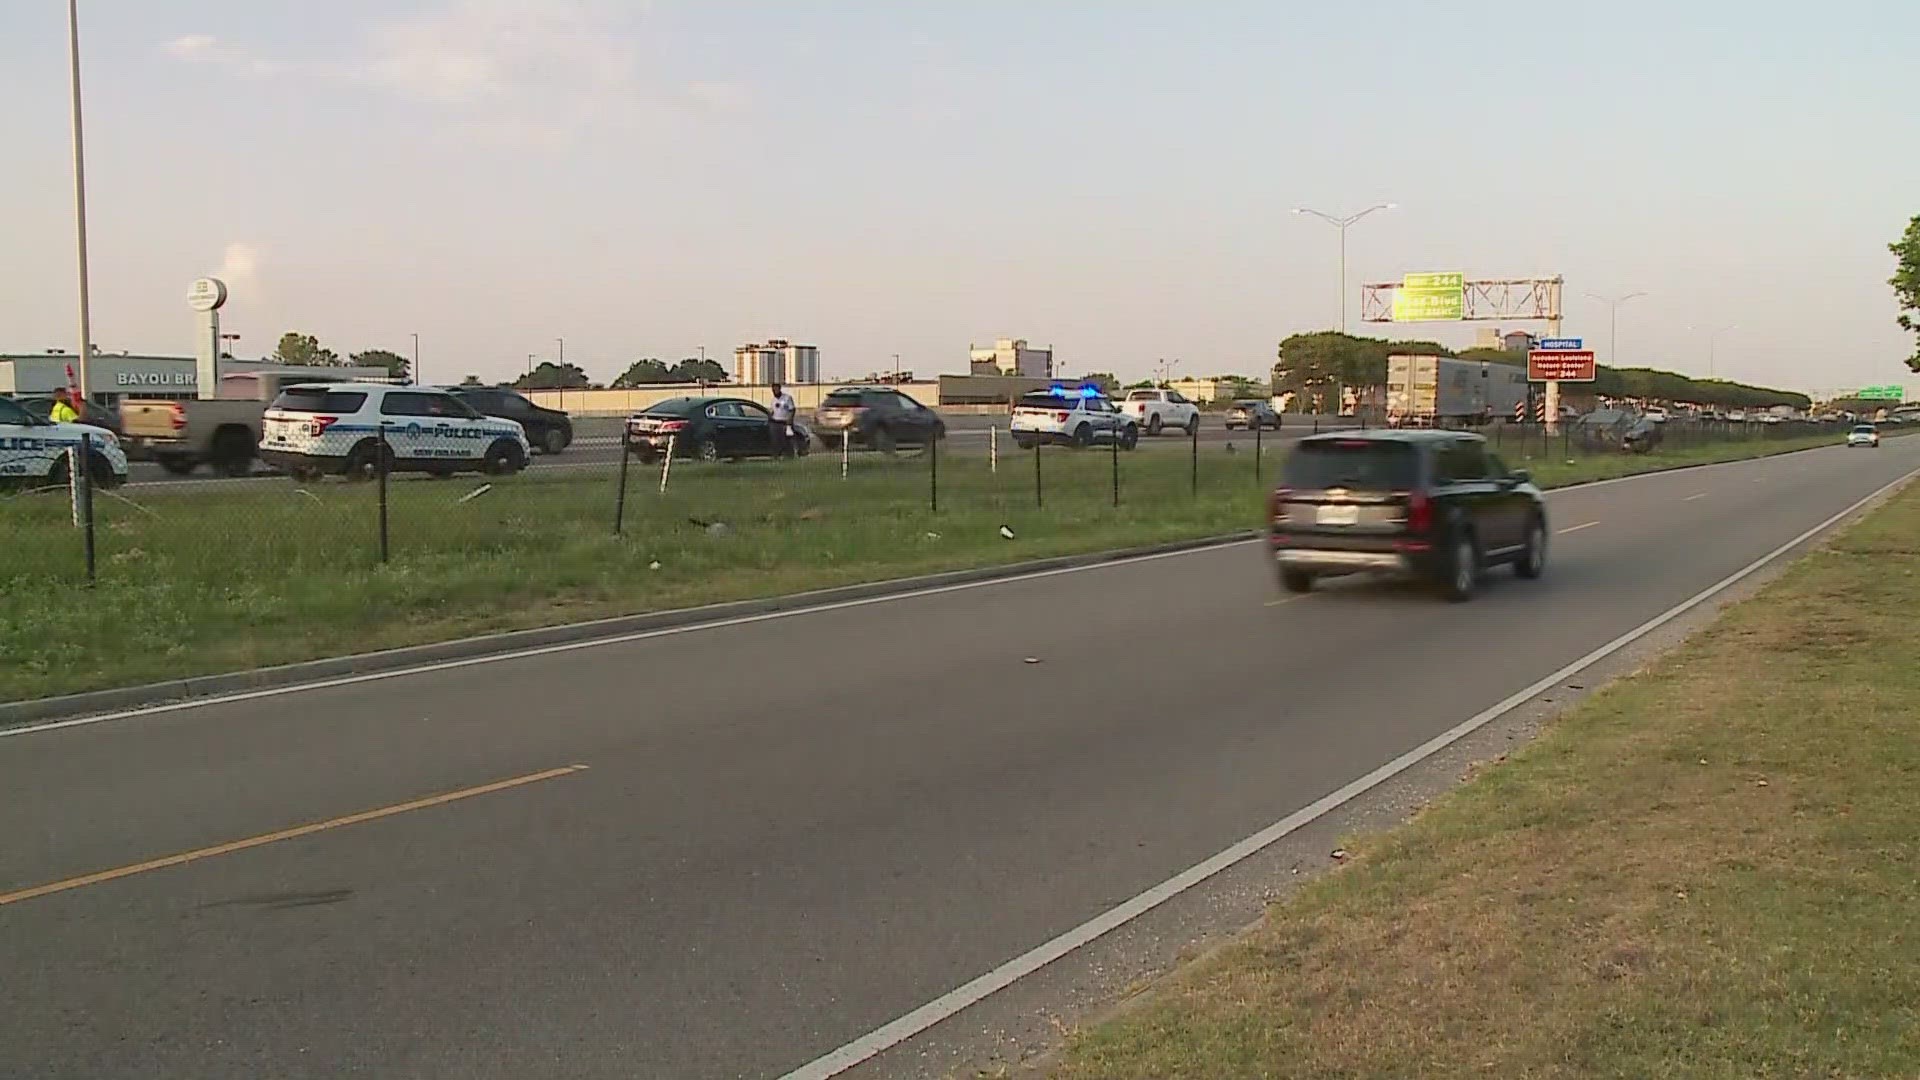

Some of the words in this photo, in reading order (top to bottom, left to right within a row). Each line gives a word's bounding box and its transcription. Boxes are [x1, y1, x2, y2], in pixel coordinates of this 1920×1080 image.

[1433, 276, 1457, 286] 244
[117, 373, 170, 385] BAYOU
[434, 427, 482, 439] POLICE
[0, 438, 44, 450] LICE
